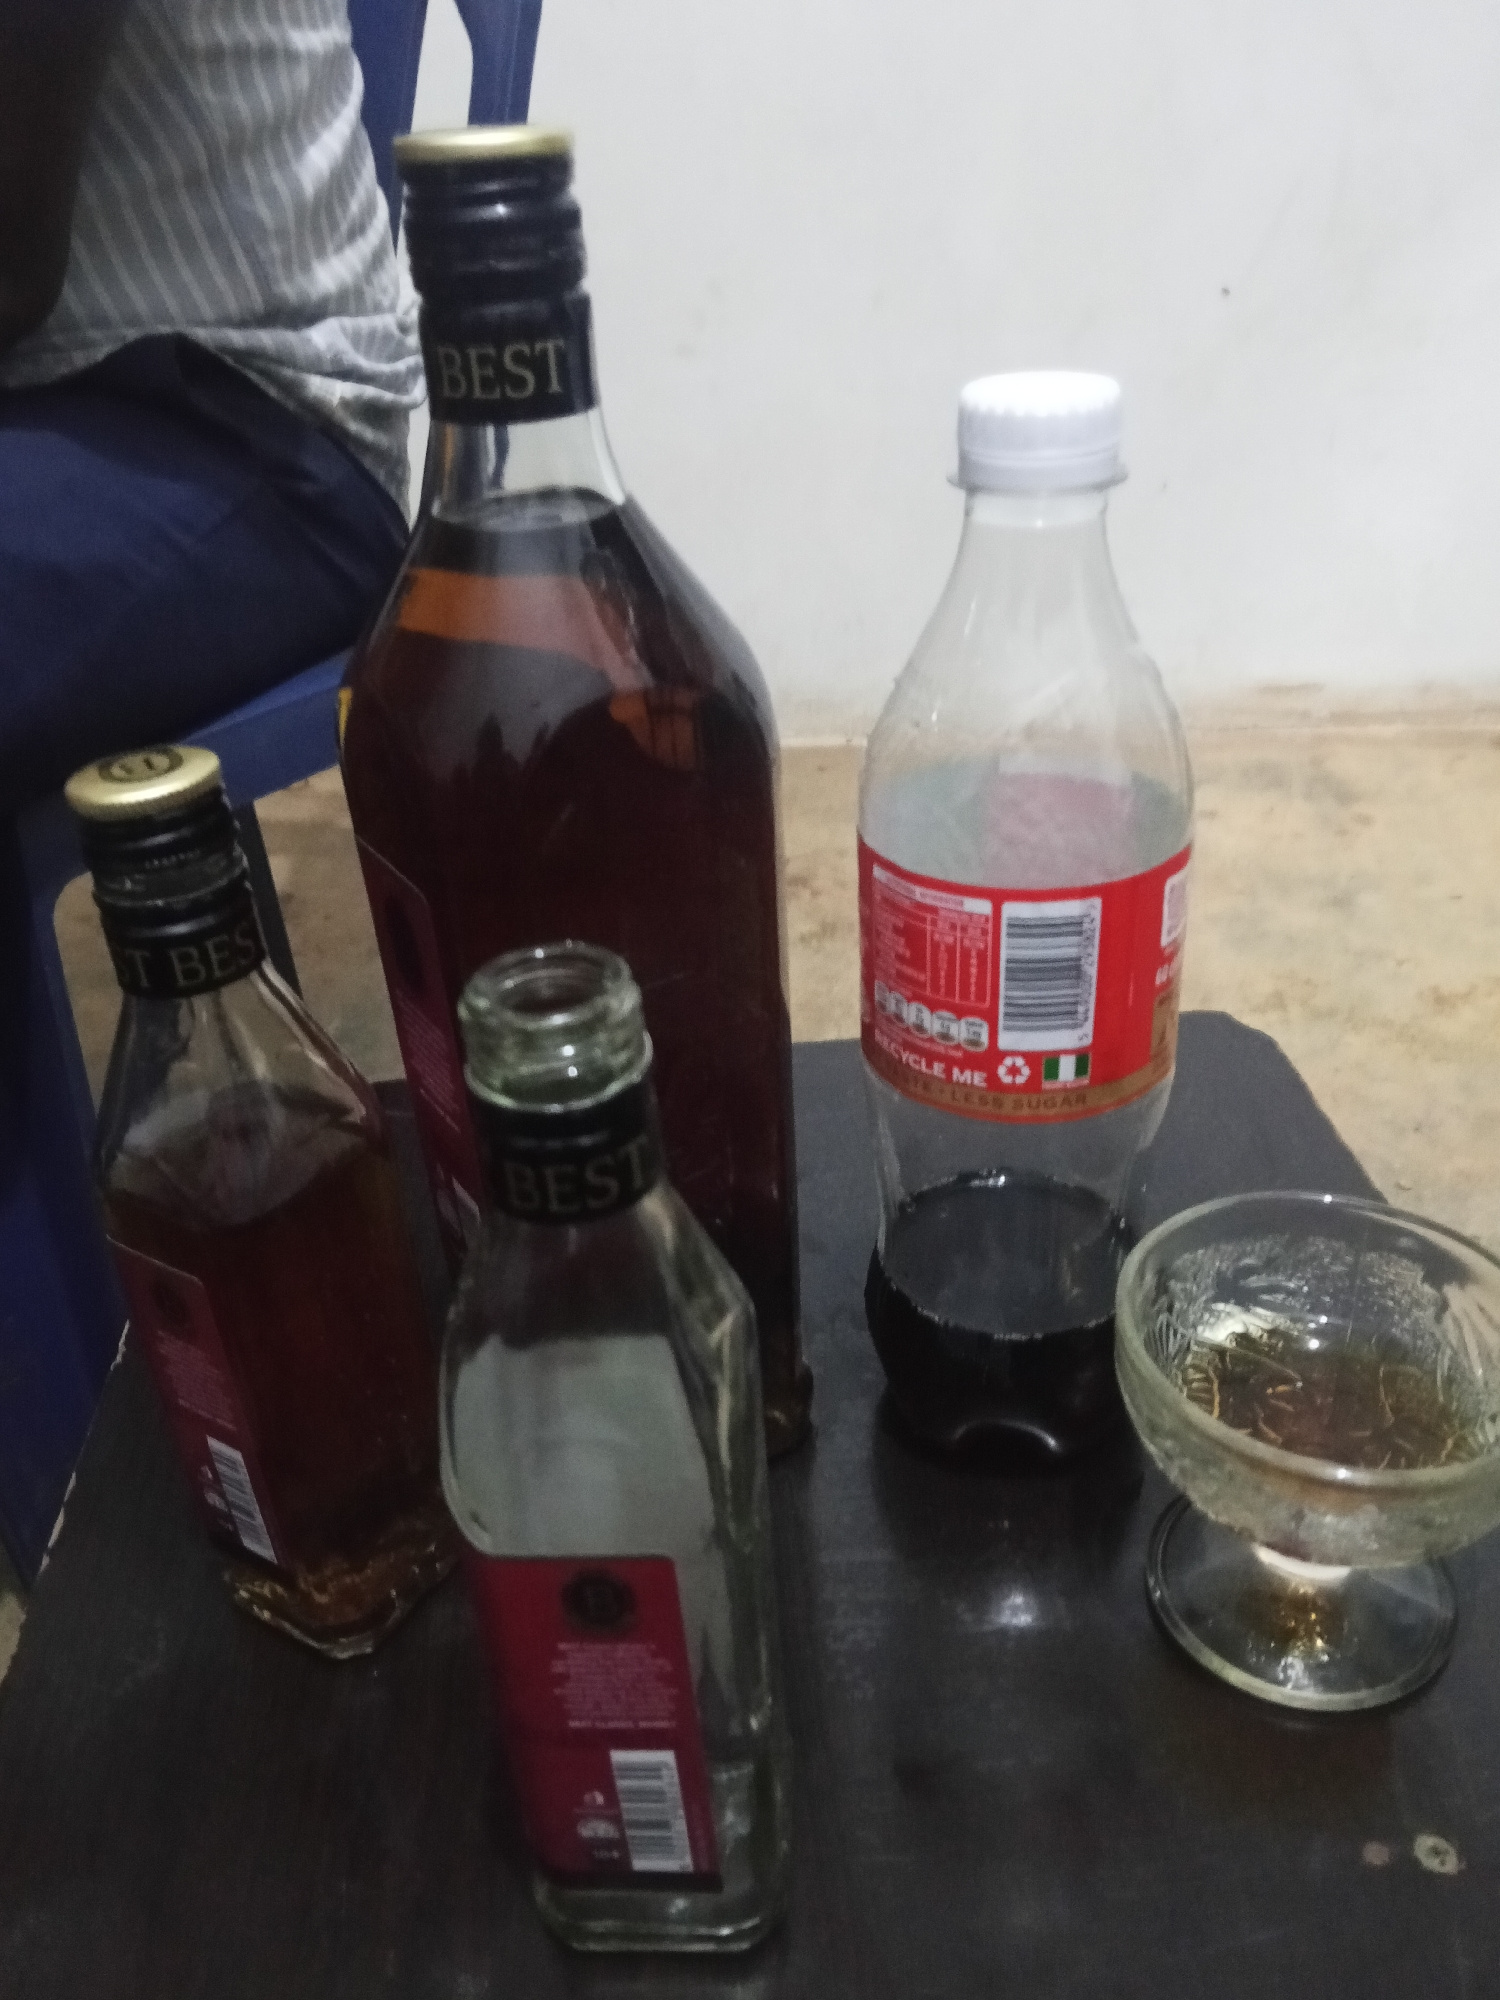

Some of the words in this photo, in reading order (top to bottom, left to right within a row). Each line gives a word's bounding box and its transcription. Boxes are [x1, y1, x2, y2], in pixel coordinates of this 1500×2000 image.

[436, 339, 565, 400] BEST
[952, 1067, 987, 1088] ME
[951, 1089, 1004, 1110] LESS
[1011, 1092, 1088, 1111] SUGAR
[503, 1133, 648, 1213] BEST
